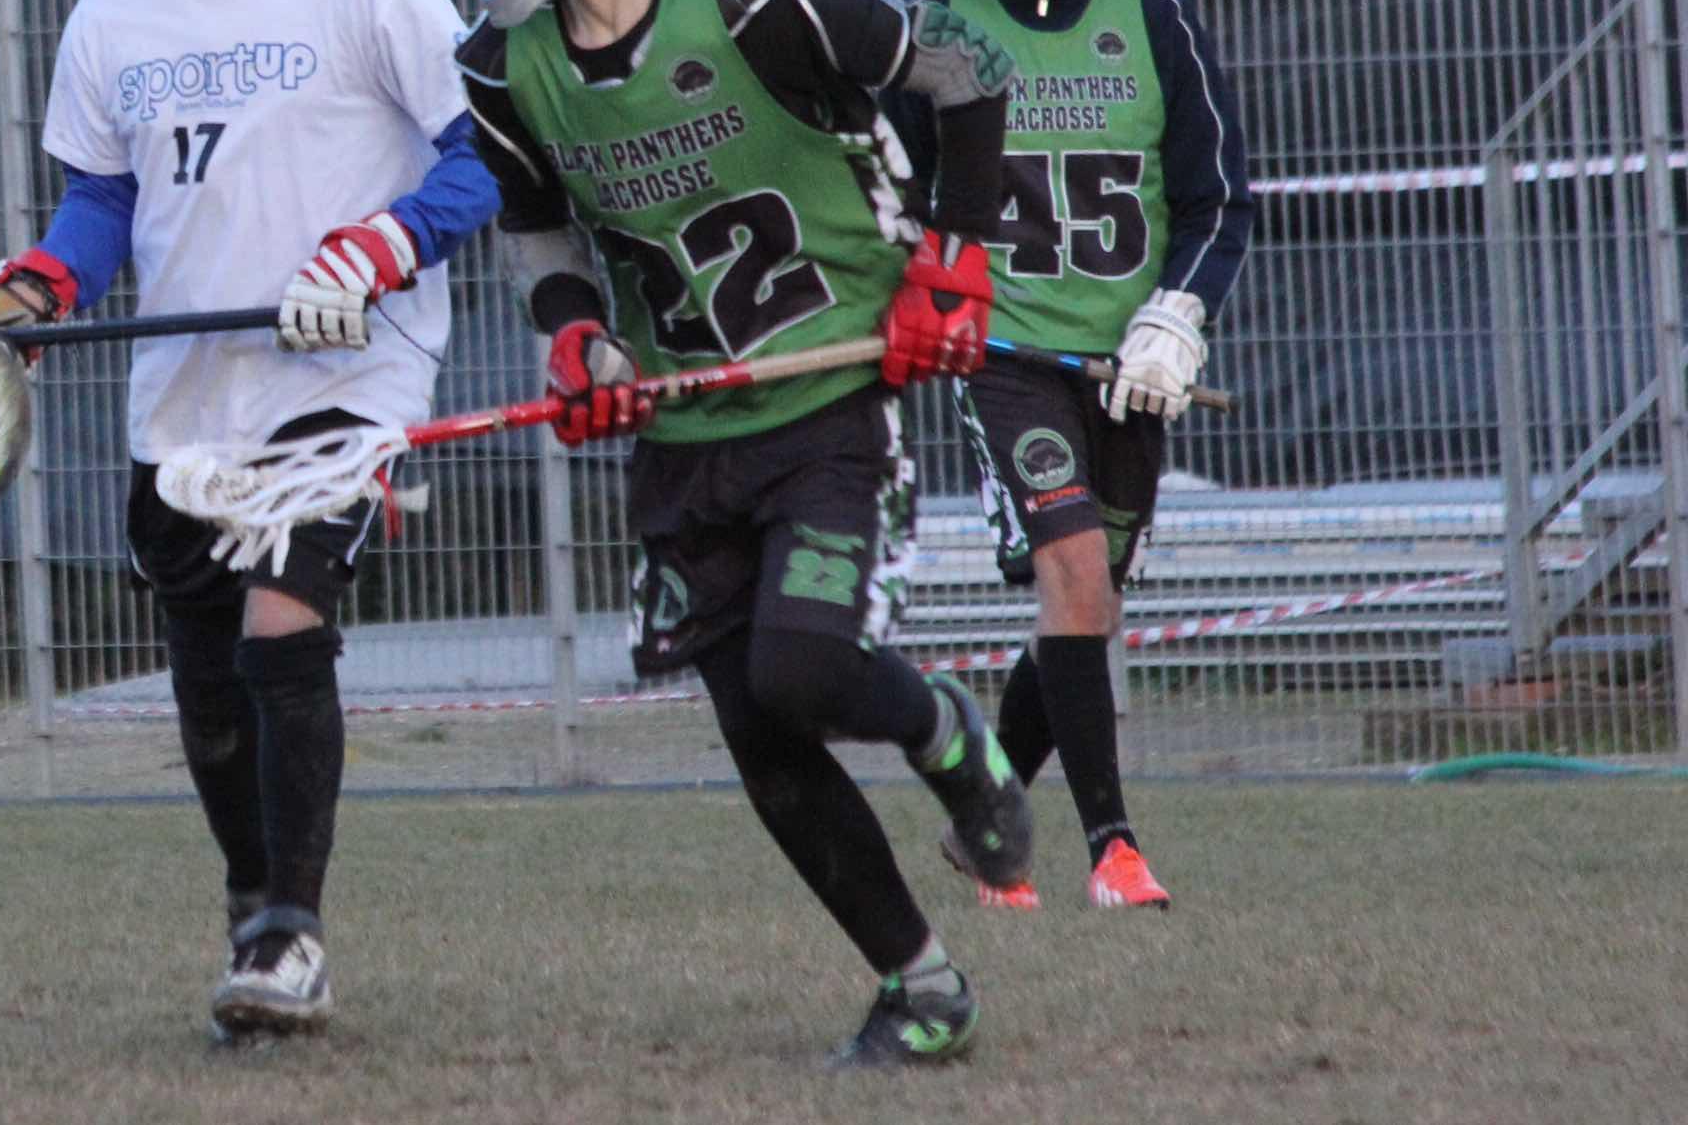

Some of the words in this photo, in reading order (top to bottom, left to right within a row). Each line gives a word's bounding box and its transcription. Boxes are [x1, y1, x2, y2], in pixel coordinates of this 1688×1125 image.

[1034, 75, 1138, 101] PANTHERS
[173, 123, 227, 186] 17
[608, 103, 746, 172] PANTHERS
[980, 150, 1150, 281] 45
